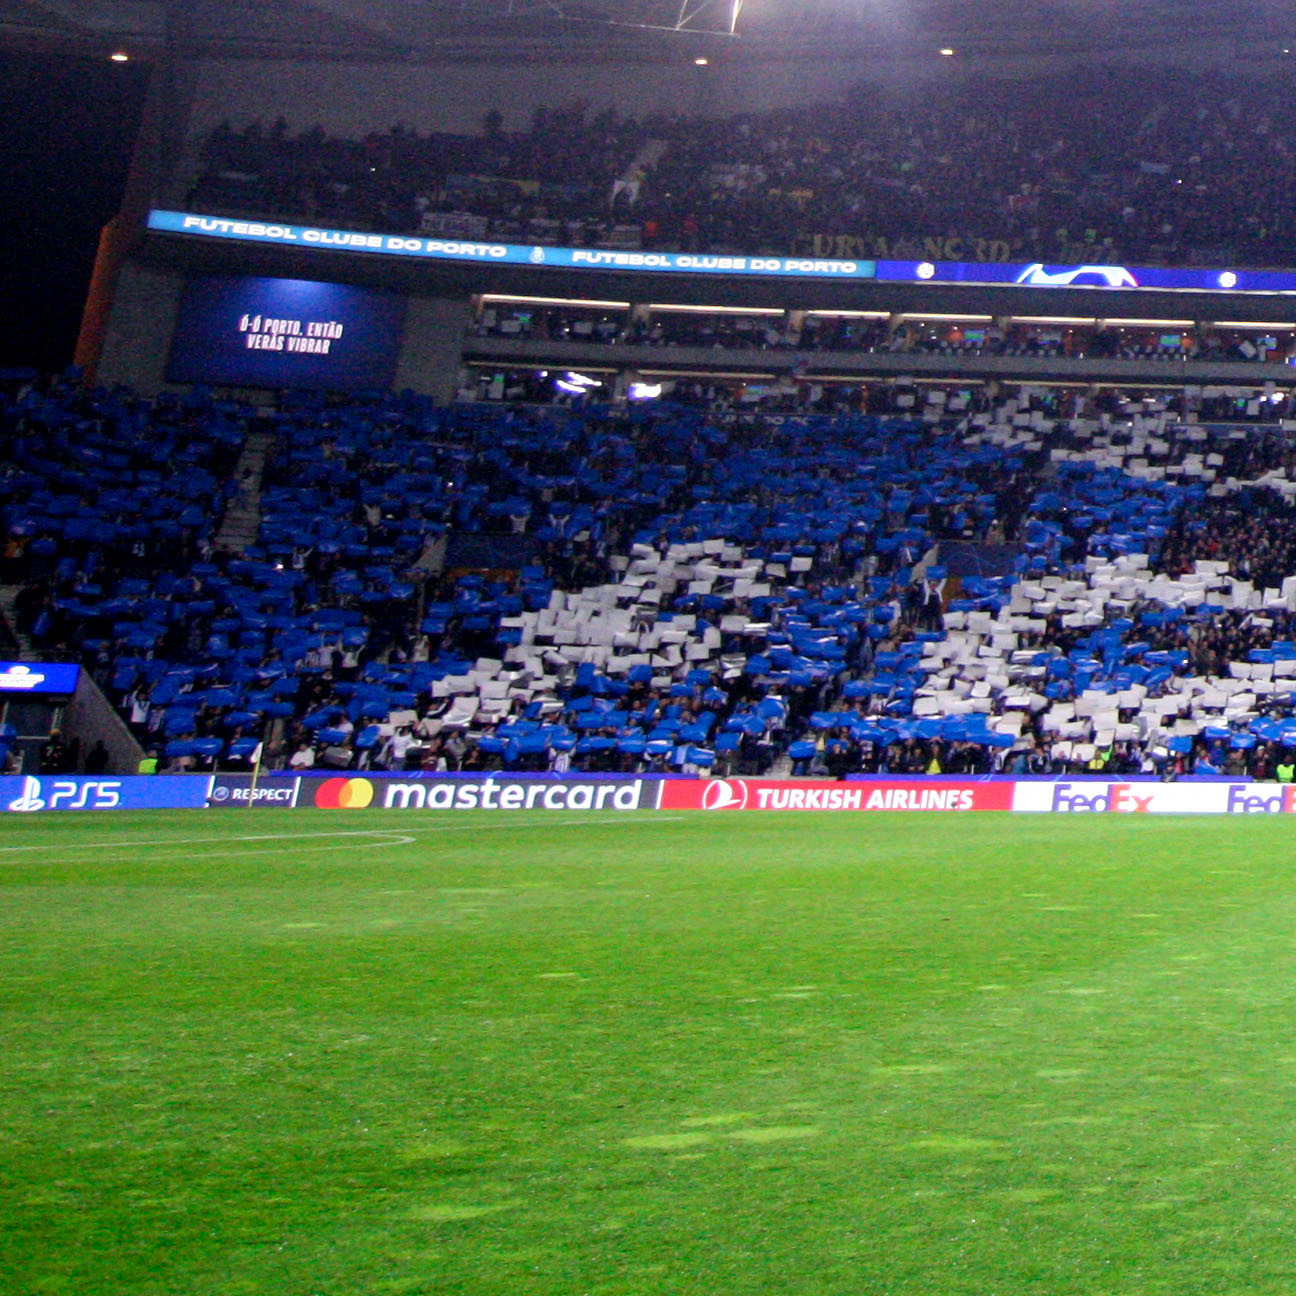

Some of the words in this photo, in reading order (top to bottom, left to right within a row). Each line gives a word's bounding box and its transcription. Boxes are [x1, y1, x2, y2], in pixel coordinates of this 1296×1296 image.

[184, 216, 297, 241] FUTEBOL
[302, 230, 383, 249] CLUBE
[387, 237, 422, 251] DO
[426, 241, 507, 258] PORTO
[572, 251, 672, 267] FUTEBOL
[676, 256, 746, 270] CLUBE
[750, 258, 781, 272] DO
[785, 259, 857, 273] PORTO
[307, 320, 344, 340] ENTÃO
[246, 332, 285, 351] VERÁS
[286, 336, 331, 354] VIBRAR
[50, 781, 122, 808] PS5
[232, 788, 294, 801] RESPECT
[383, 778, 643, 810] mastercard
[756, 788, 857, 809] TURKISH
[865, 789, 974, 810] AIRLINES
[1051, 783, 1155, 813] FedEx
